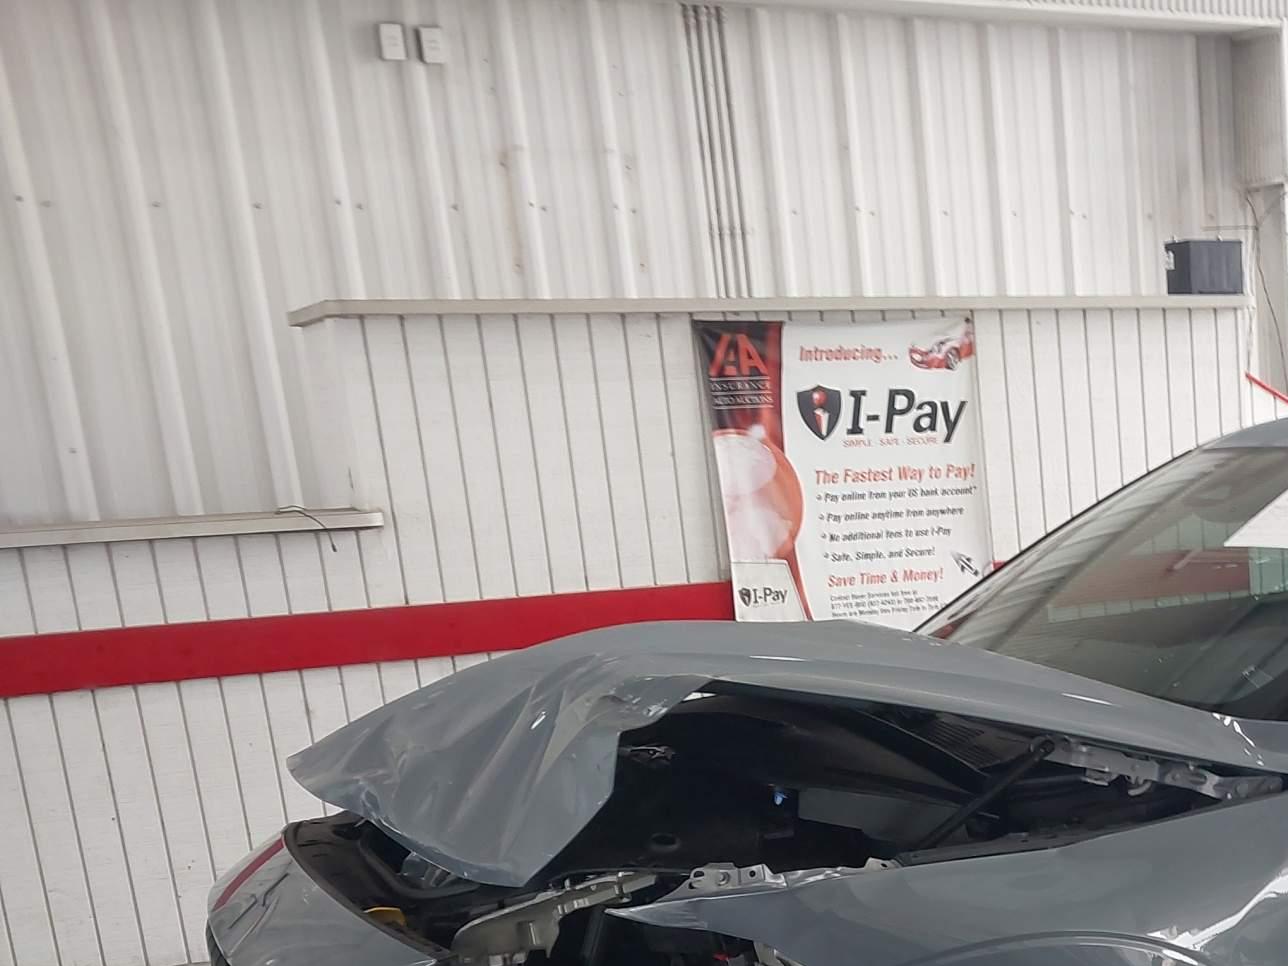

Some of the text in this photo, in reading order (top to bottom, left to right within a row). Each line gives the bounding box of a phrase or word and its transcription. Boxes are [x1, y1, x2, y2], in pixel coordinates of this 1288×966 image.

[846, 388, 968, 443] I-Pay
[815, 463, 976, 485] The Fastest Way to Pay!
[824, 493, 839, 503] Pay
[841, 489, 866, 500] online
[868, 489, 887, 499] from
[888, 490, 906, 500] your
[920, 486, 939, 496] bank
[826, 506, 964, 523] Pay online anytime from anywhere
[842, 530, 883, 541] additional
[885, 529, 903, 538] fees
[905, 529, 914, 537] to
[915, 529, 929, 537] use
[887, 550, 903, 559] and
[904, 546, 936, 558] Secure!
[827, 567, 944, 588] Save Time & Money!
[752, 587, 787, 604] I-Pay
